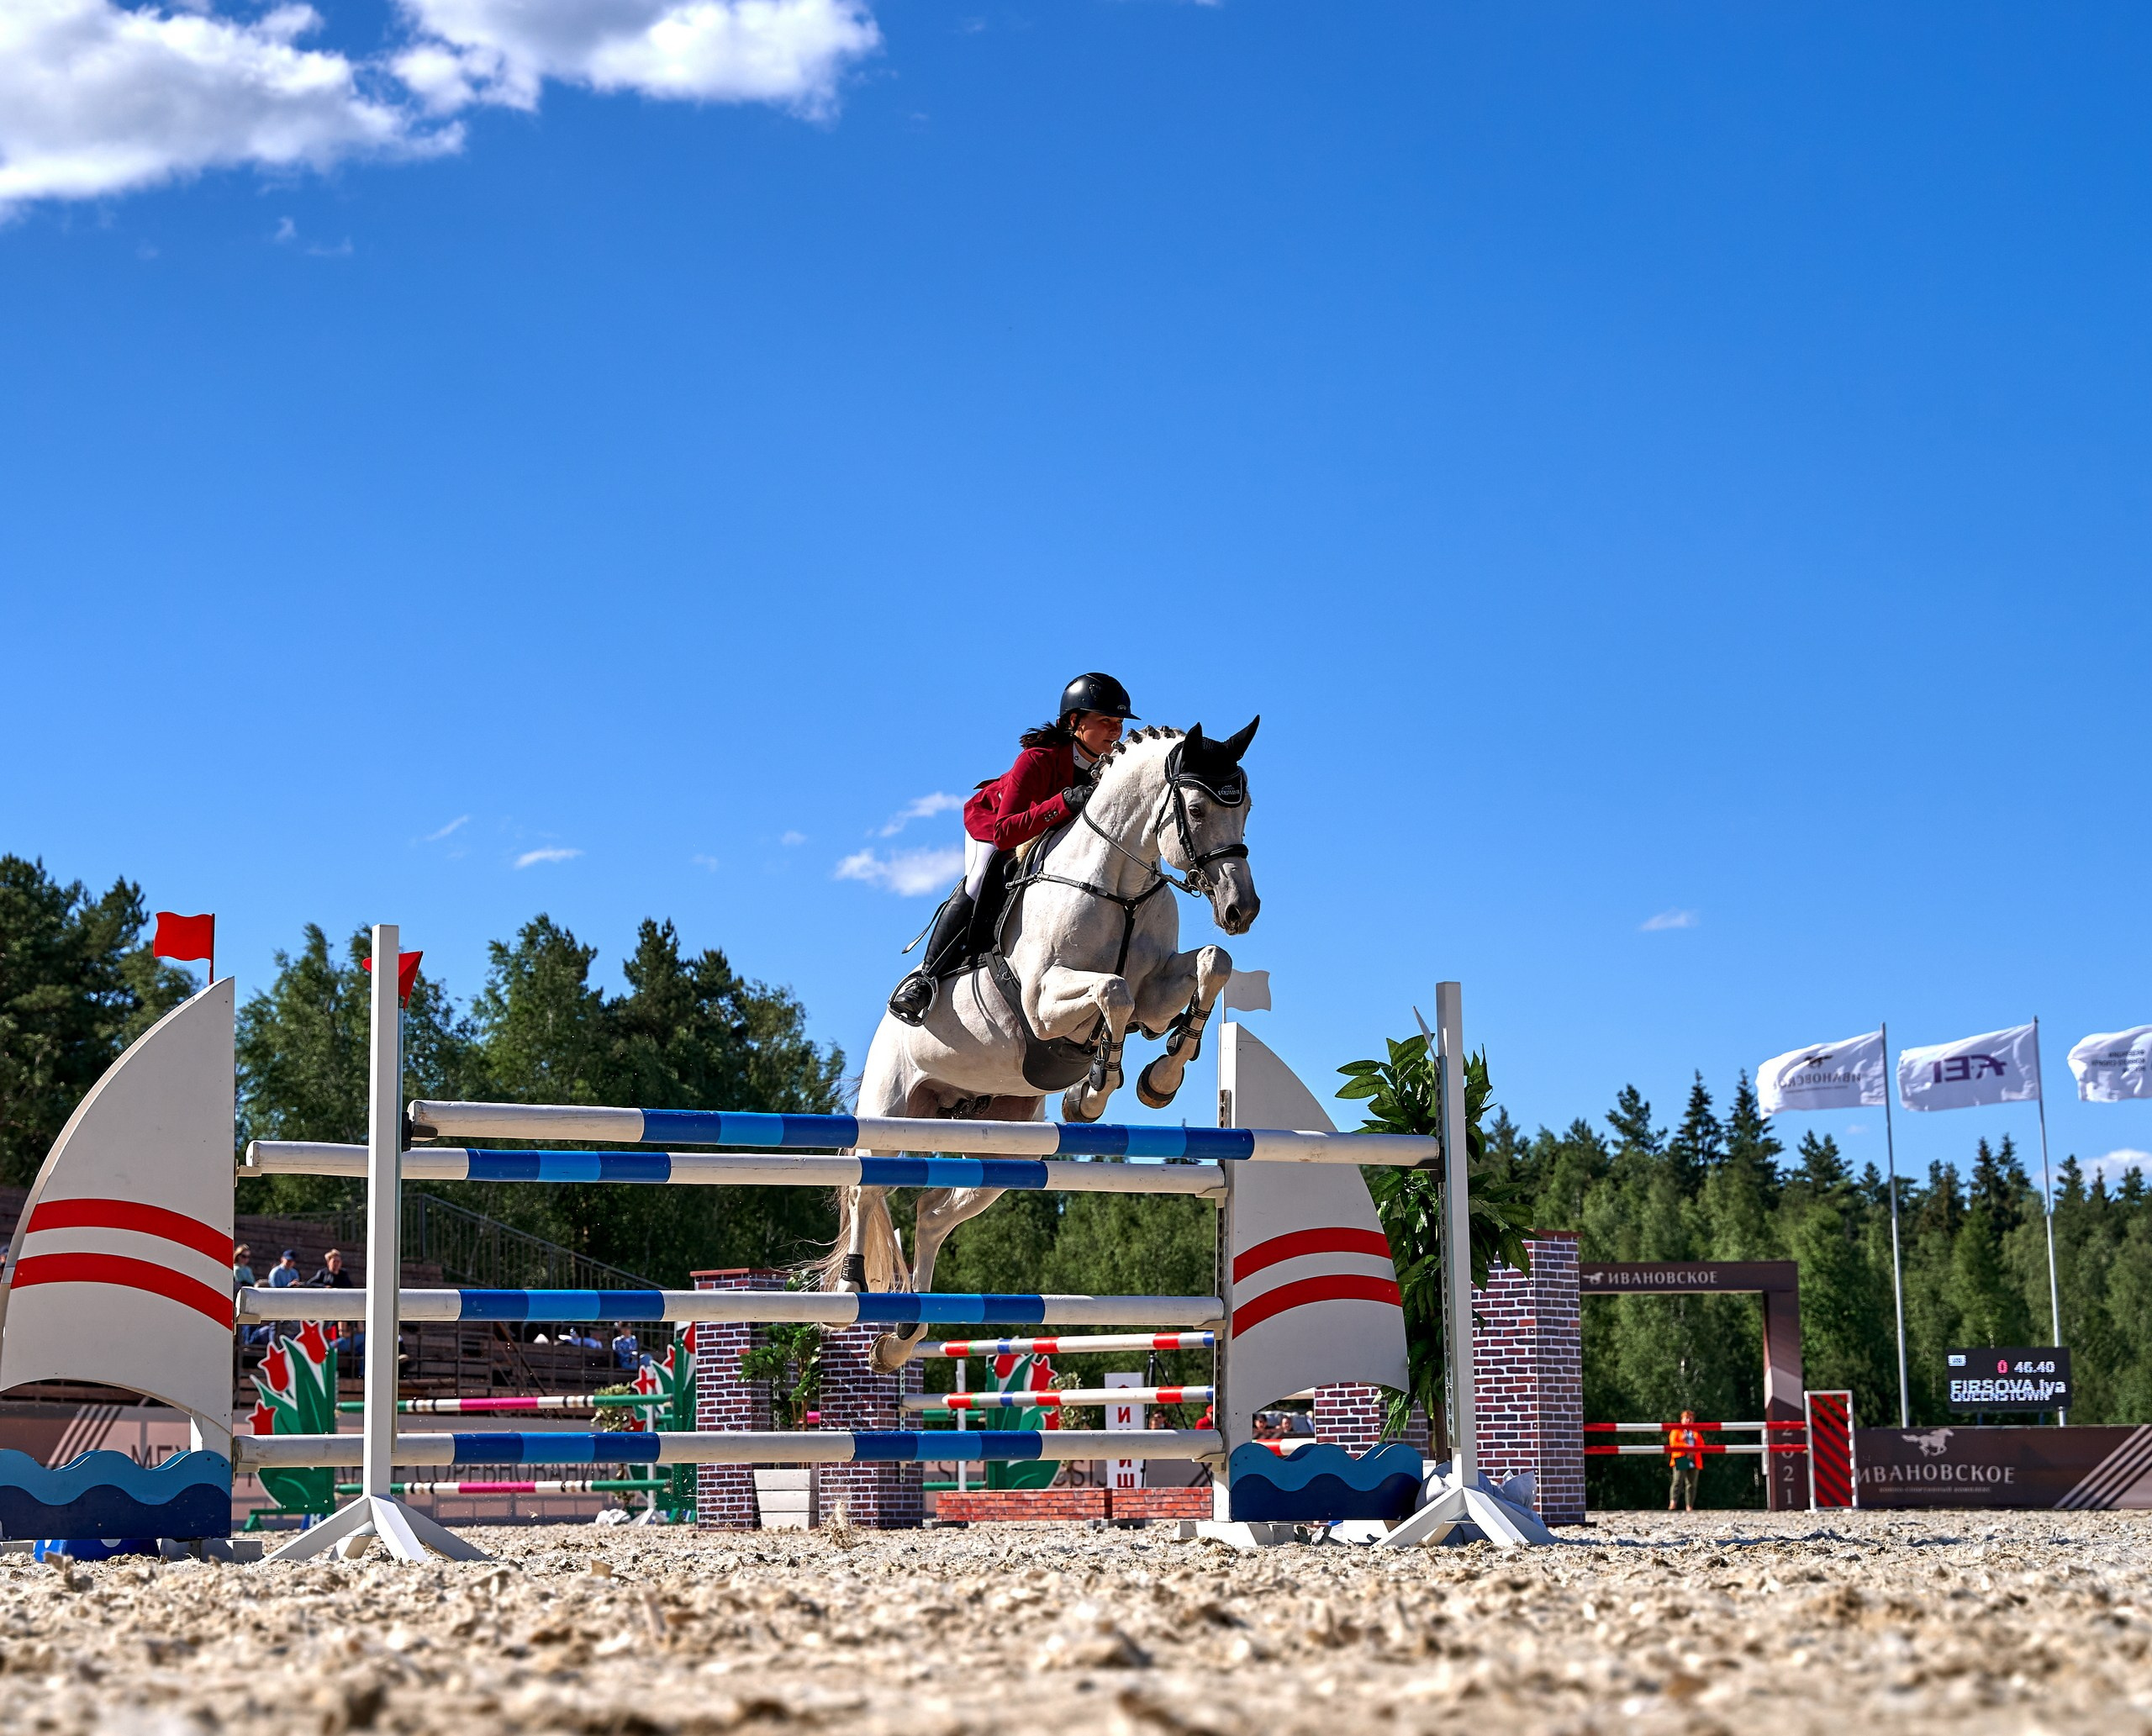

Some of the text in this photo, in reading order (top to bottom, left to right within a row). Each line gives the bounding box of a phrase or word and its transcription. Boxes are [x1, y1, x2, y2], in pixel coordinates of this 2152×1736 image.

[1608, 1271, 1718, 1285] ИВАНОВСКОЕ
[1996, 1359, 2008, 1374] 0
[1117, 1385, 1134, 1488] ИИШ
[1856, 1464, 2015, 1485] ИВАНОВСКОЕ
